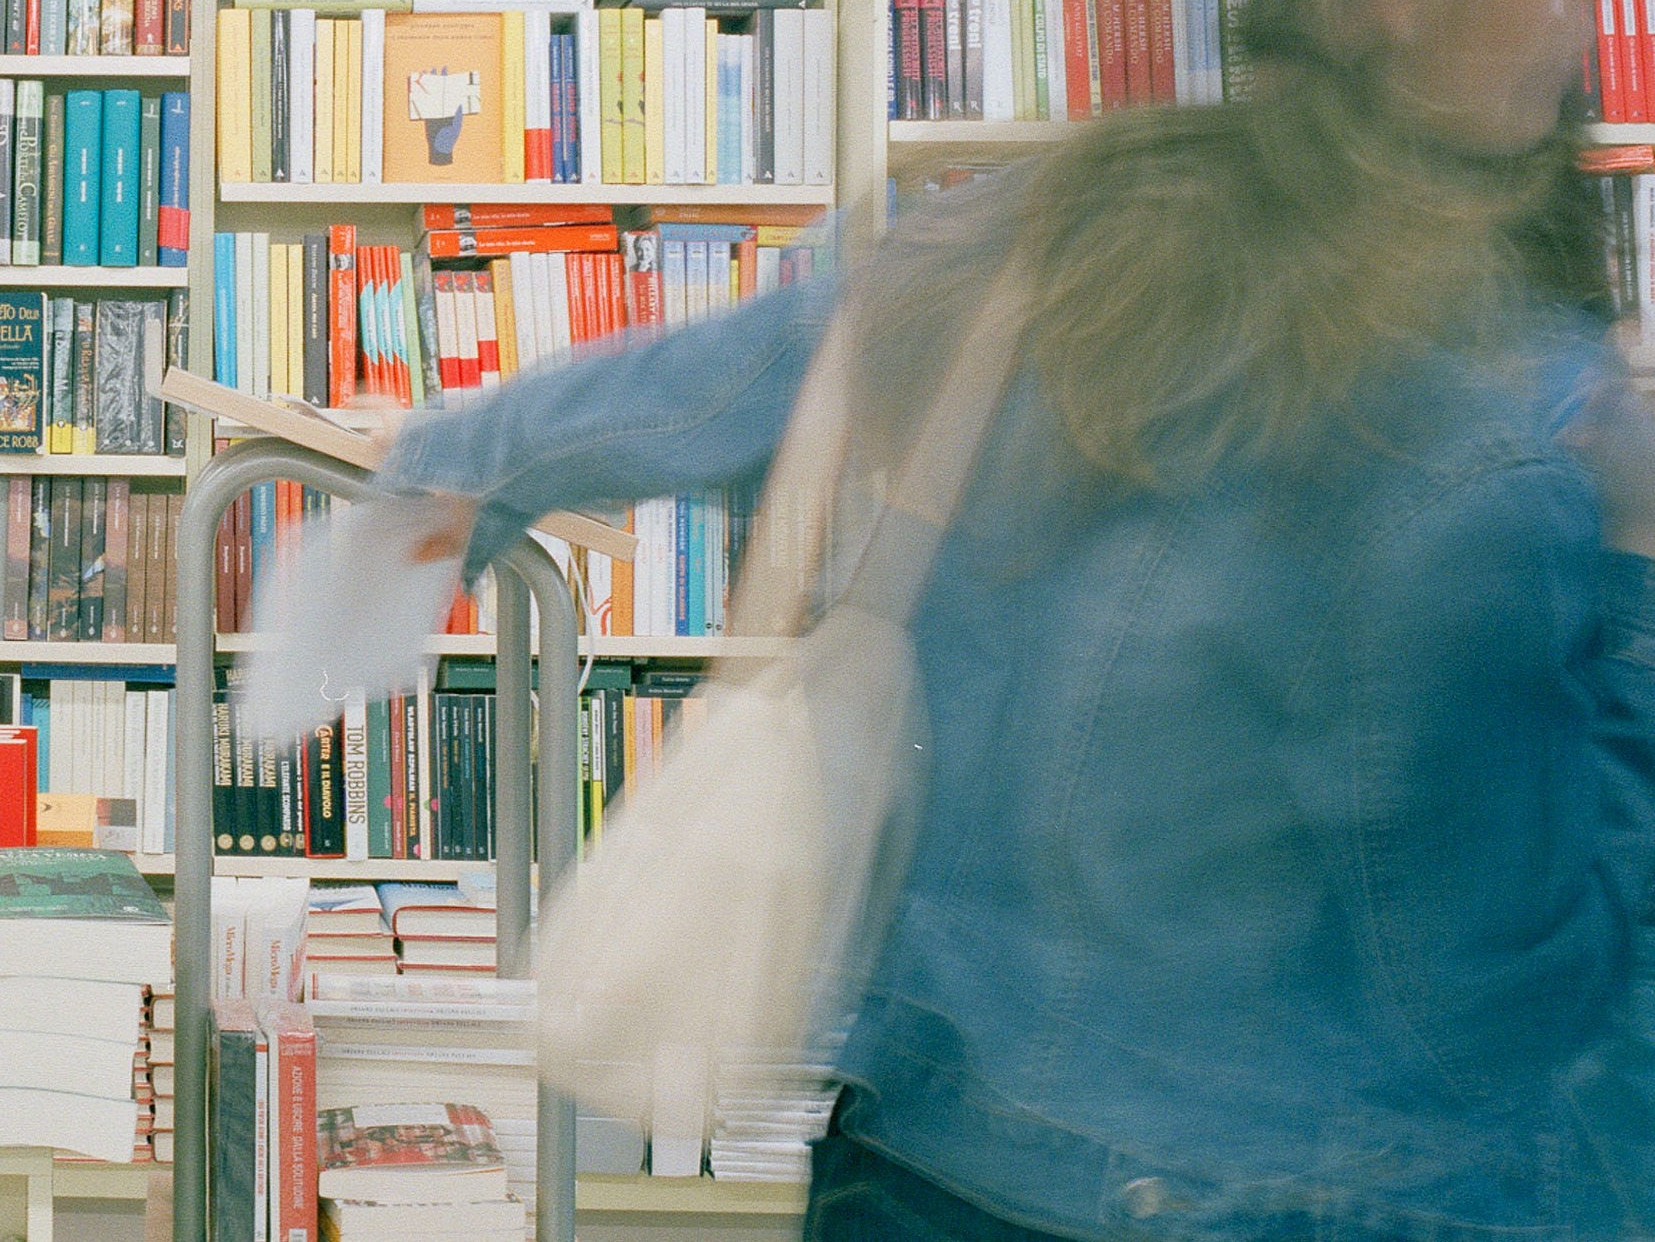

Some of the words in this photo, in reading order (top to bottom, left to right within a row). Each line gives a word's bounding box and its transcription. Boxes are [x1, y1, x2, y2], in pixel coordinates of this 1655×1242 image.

[1035, 13, 1044, 40] COLPO
[1104, 10, 1113, 64] COMANDO
[1154, 10, 1164, 64] COMANDO
[1037, 54, 1046, 79] STATO
[12, 434, 38, 448] ROBB
[218, 703, 230, 736] HARUKI
[346, 726, 364, 755] TOM
[219, 737, 232, 787] MURAKAMI
[347, 760, 366, 825] ROBBINS
[292, 1066, 303, 1095] AZIONE
[292, 1104, 303, 1132] USCIRE
[292, 1135, 304, 1160] DALLA
[292, 1162, 305, 1209] SOLITUDINE
